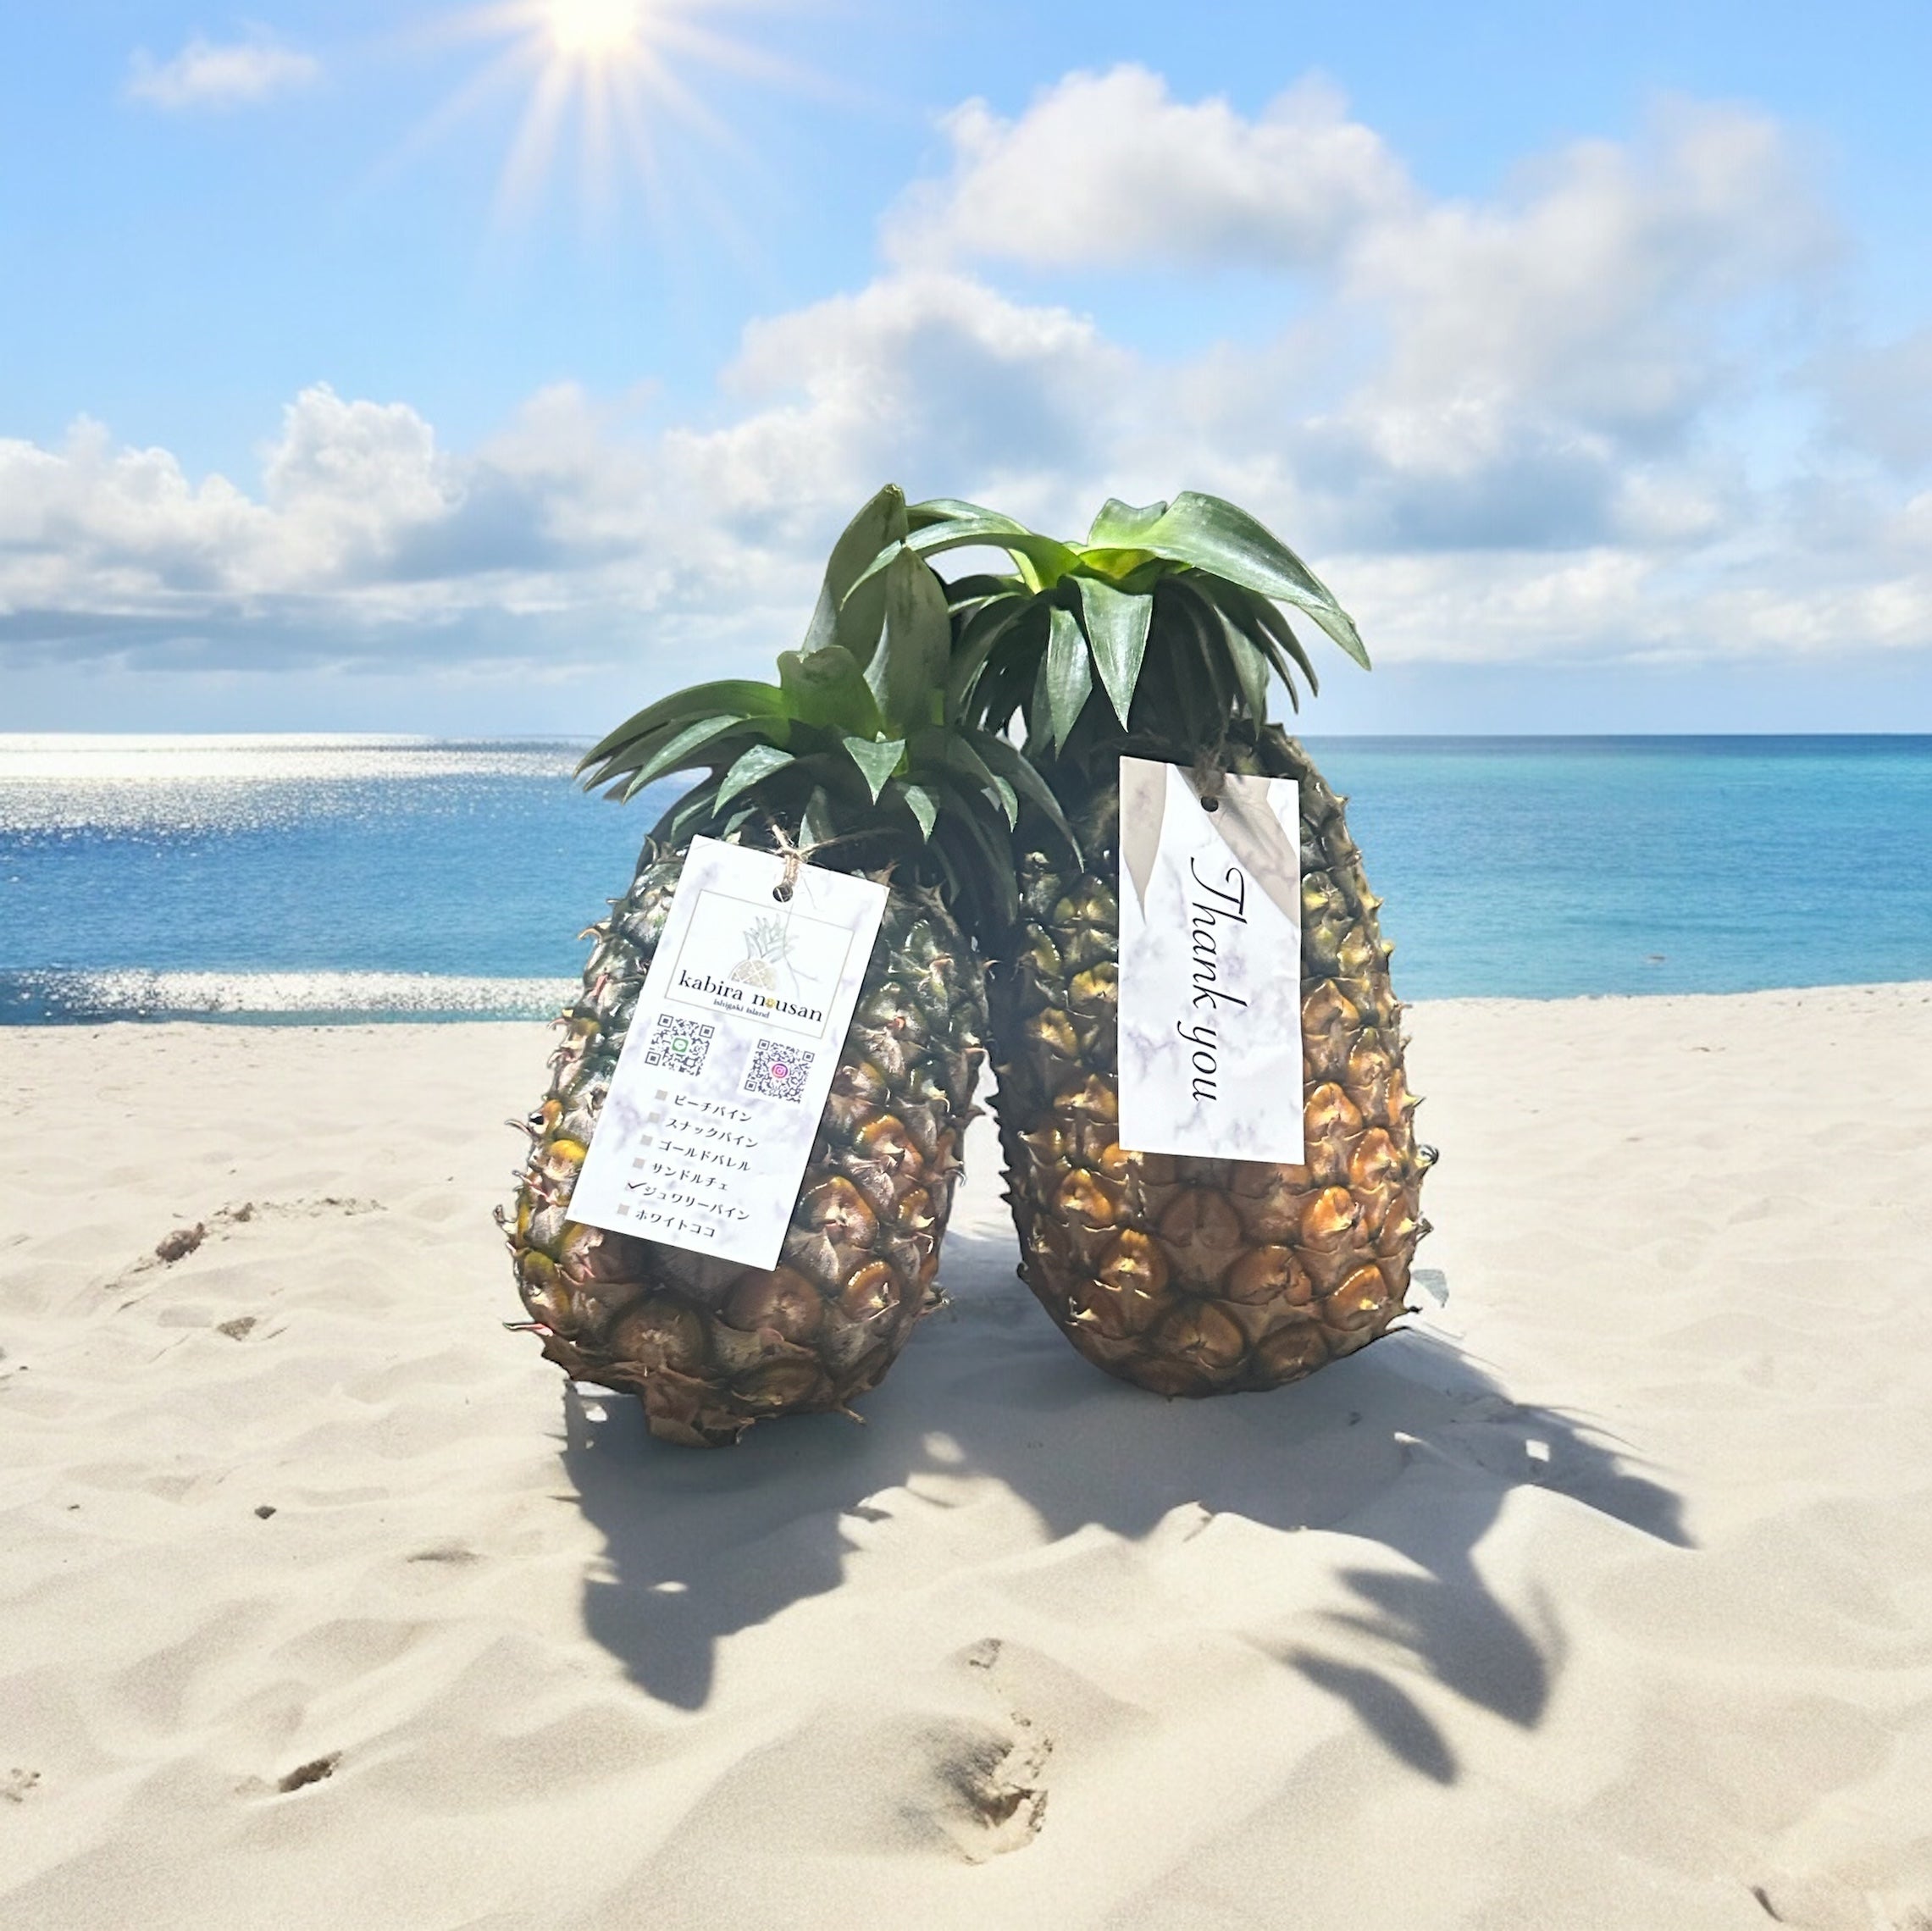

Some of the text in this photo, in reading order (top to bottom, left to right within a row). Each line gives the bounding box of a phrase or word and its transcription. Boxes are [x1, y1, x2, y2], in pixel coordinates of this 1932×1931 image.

[678, 969, 743, 1000] kabira
[1176, 856, 1248, 1102] Thank you
[713, 998, 771, 1020] ishigaki island
[658, 1139, 751, 1172] ゴールドバレル
[652, 1161, 728, 1192] サンドルチェ
[635, 1209, 716, 1238] ホワイトココ
